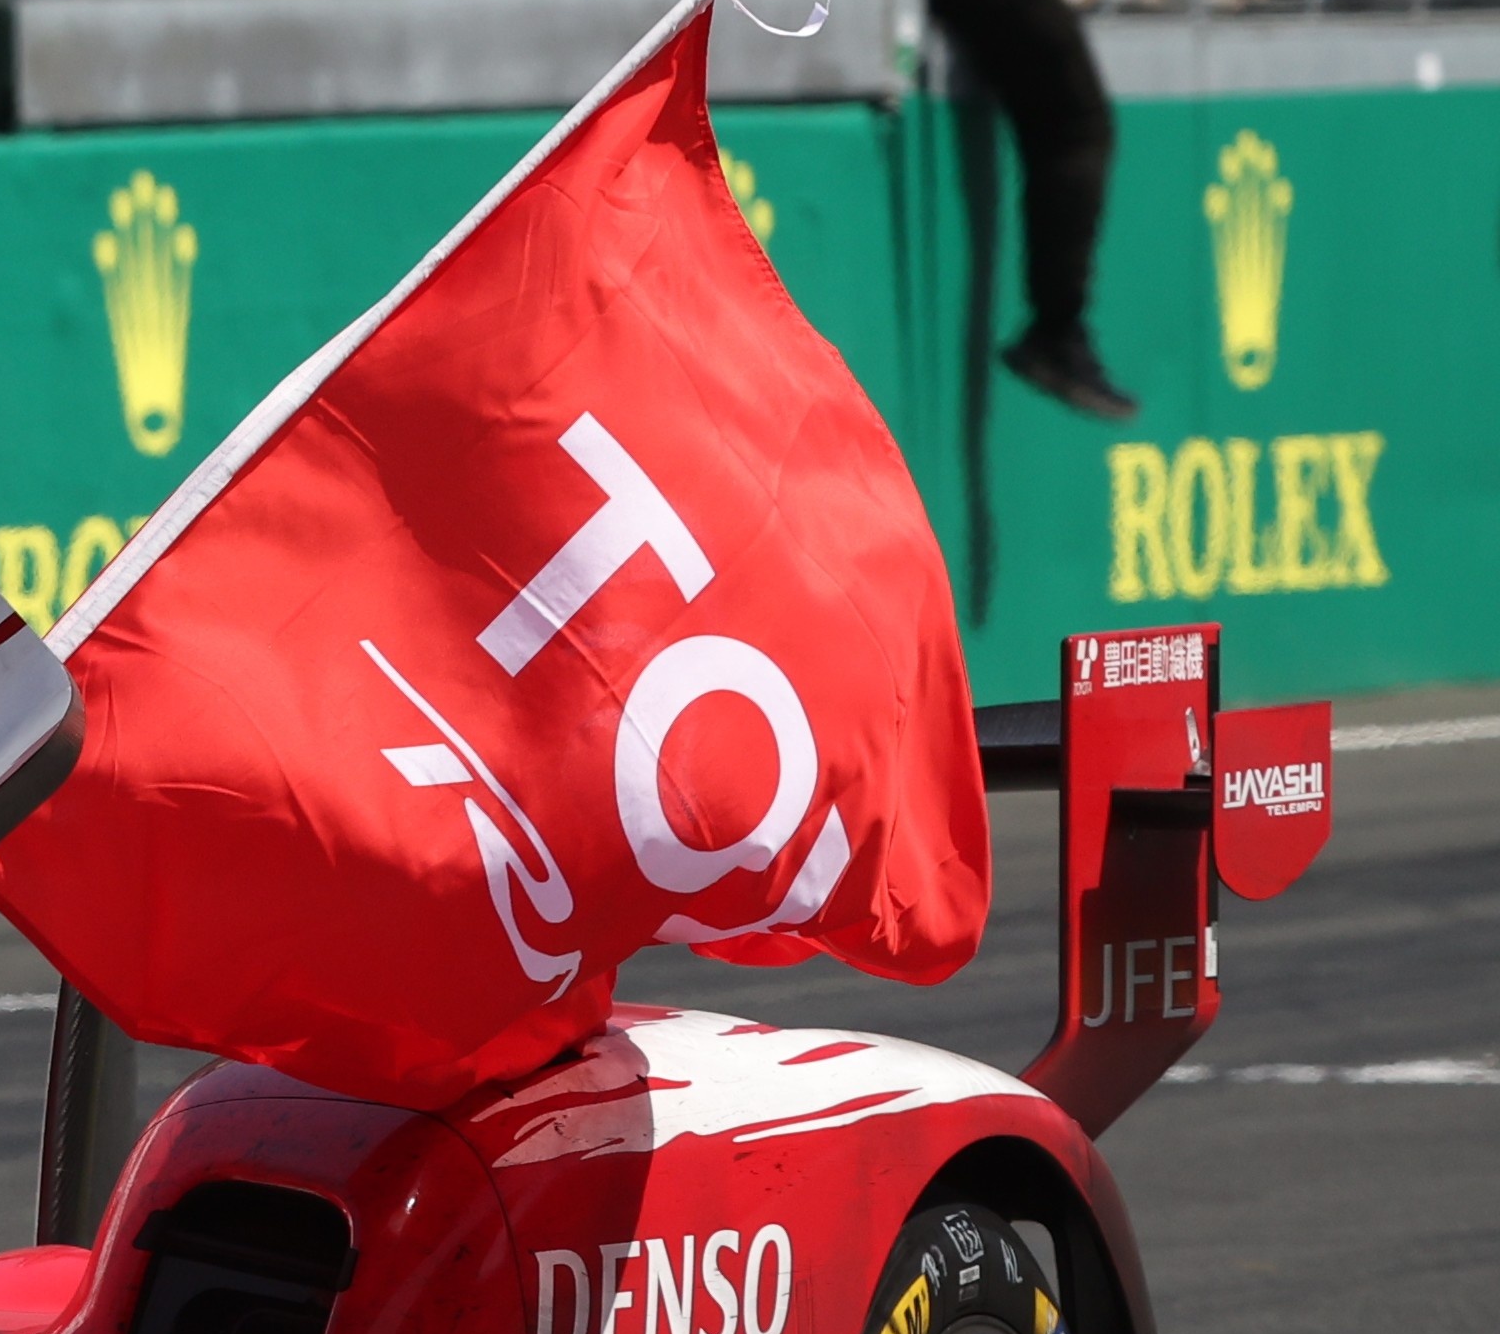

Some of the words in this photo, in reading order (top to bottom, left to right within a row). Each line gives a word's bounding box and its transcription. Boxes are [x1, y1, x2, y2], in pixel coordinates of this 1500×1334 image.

[1105, 431, 1389, 602] ROLEX
[1222, 762, 1325, 809] HAYASHI
[1265, 800, 1322, 817] TELEMPU
[1081, 936, 1196, 1029] JFE
